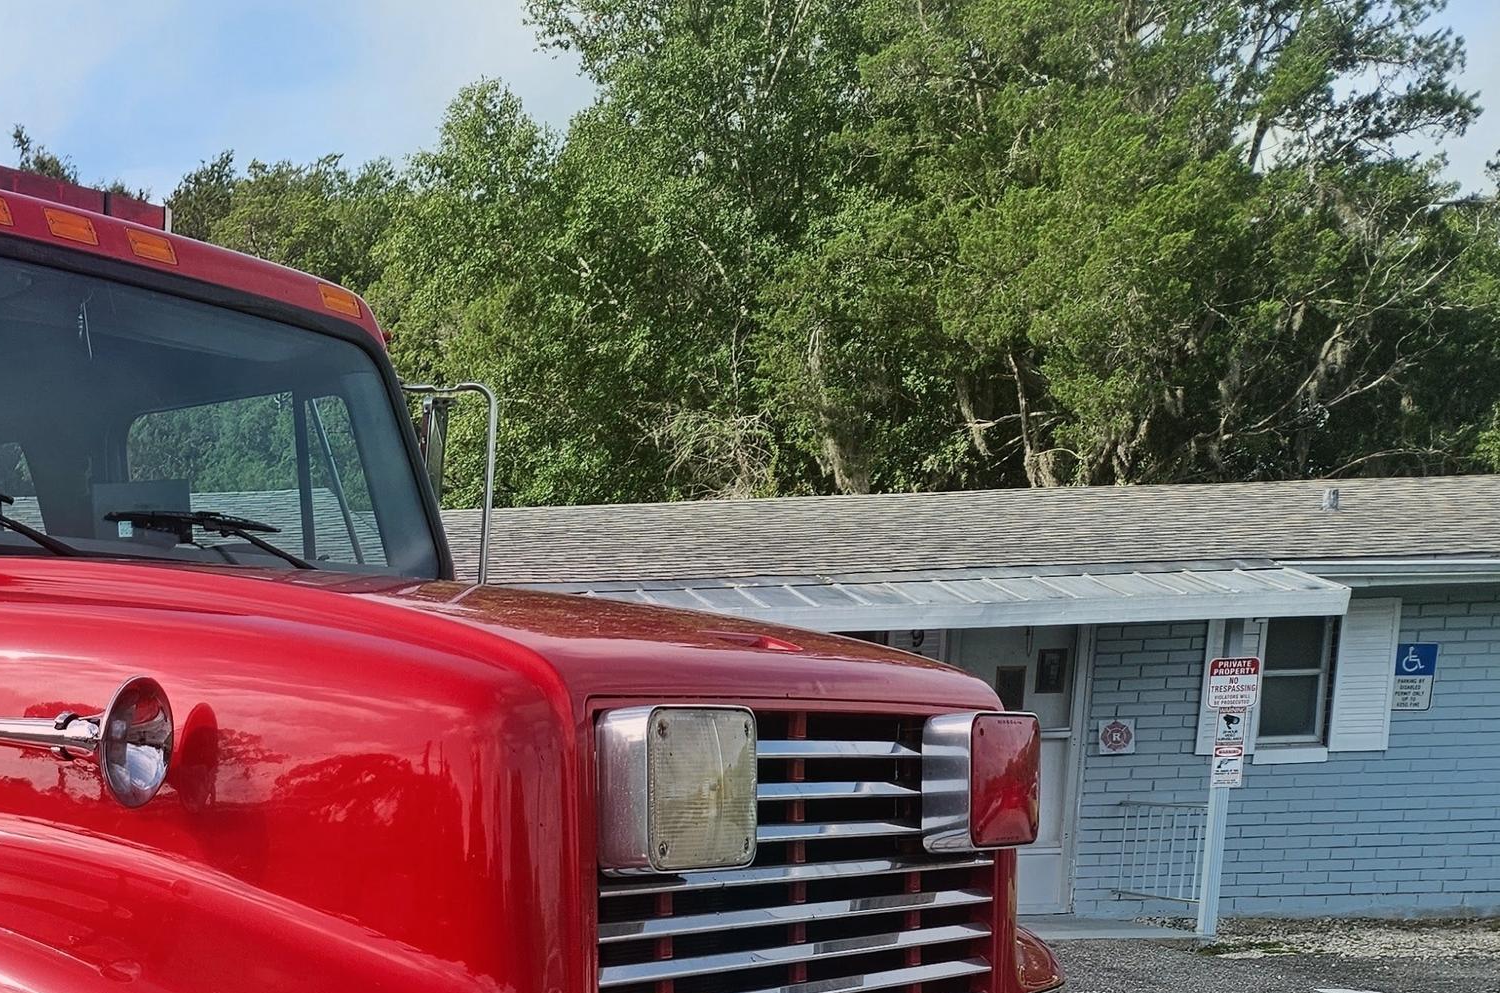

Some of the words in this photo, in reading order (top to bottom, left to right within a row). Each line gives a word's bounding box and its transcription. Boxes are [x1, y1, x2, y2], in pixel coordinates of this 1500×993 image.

[1218, 659, 1252, 668] PRIVATE
[1213, 667, 1256, 676] PROPERTY
[1228, 677, 1239, 685] NO
[1211, 684, 1256, 693] TRESPASSING
[1112, 732, 1121, 742] R
